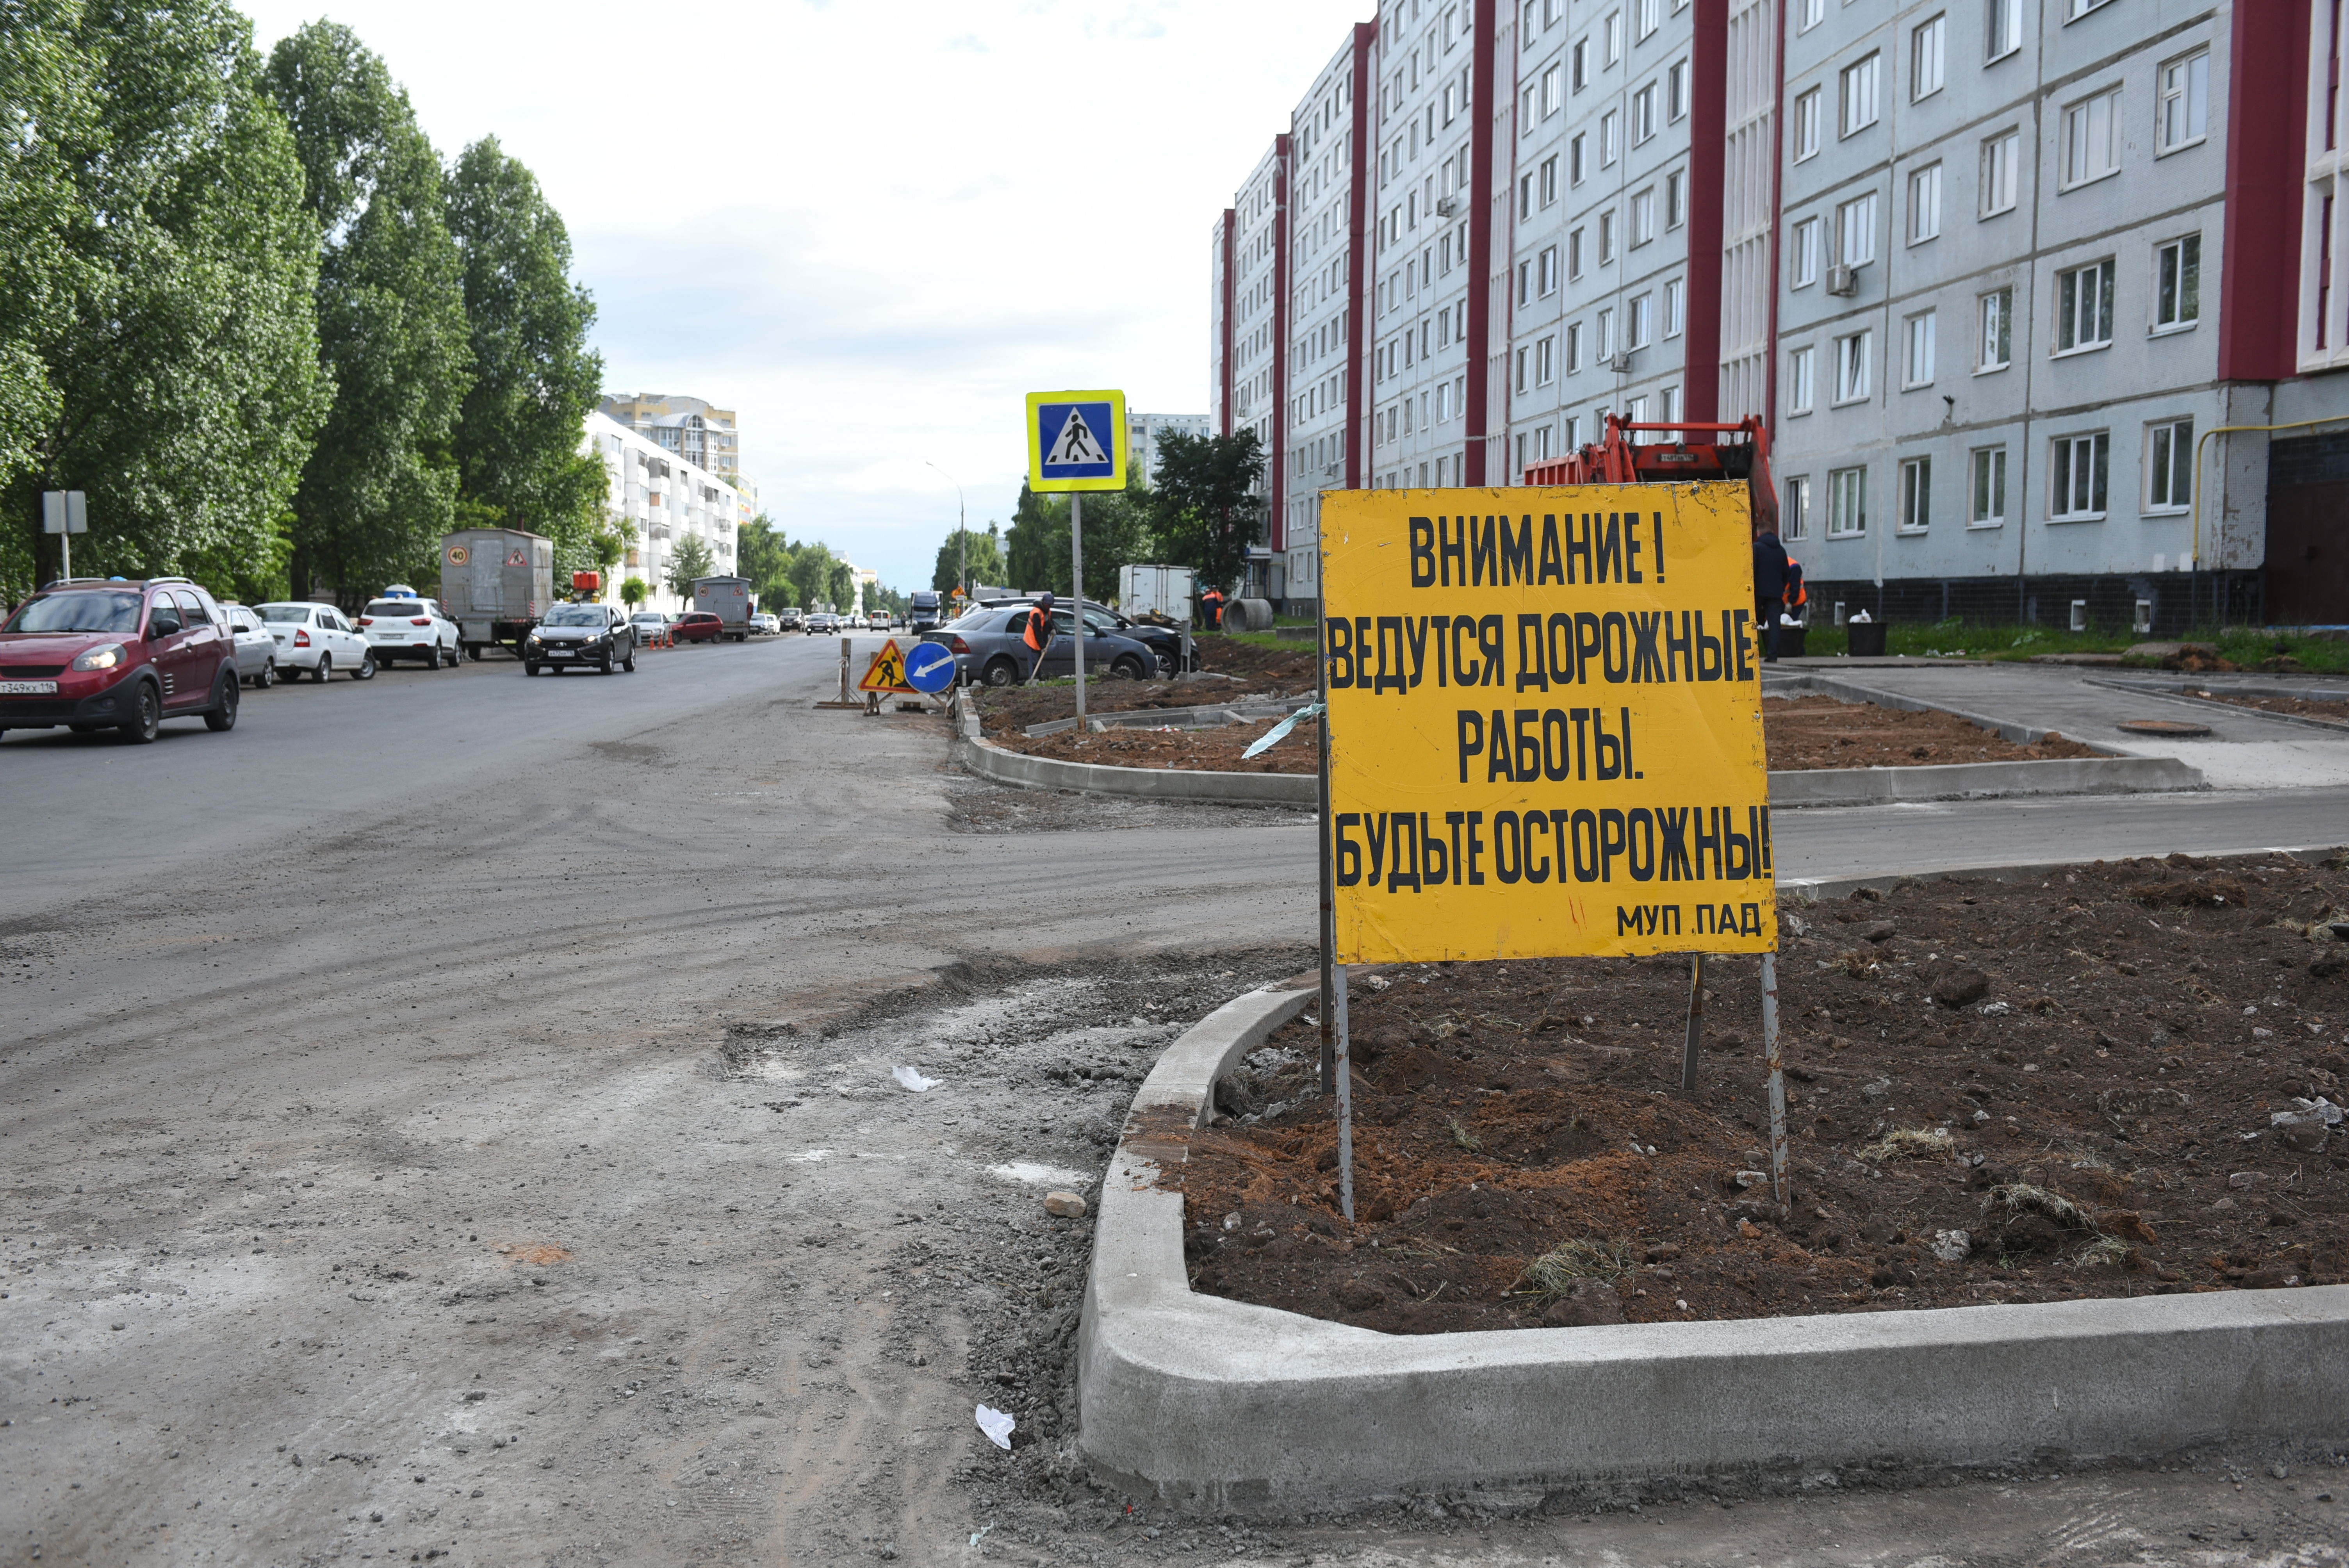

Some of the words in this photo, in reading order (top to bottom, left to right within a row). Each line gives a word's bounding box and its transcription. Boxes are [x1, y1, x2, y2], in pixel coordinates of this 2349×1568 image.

[452, 551, 463, 561] 40
[1326, 614, 1504, 695] ВЕДУТСЯ
[1516, 609, 1754, 693] ДОРОЖНЫЕ
[1457, 707, 1643, 783] РАБОТЫ.
[1335, 811, 1485, 894] БУДЬТЕ
[1494, 805, 1772, 884] ОСТОРОЖНЫ!
[1617, 905, 1681, 937] МУП
